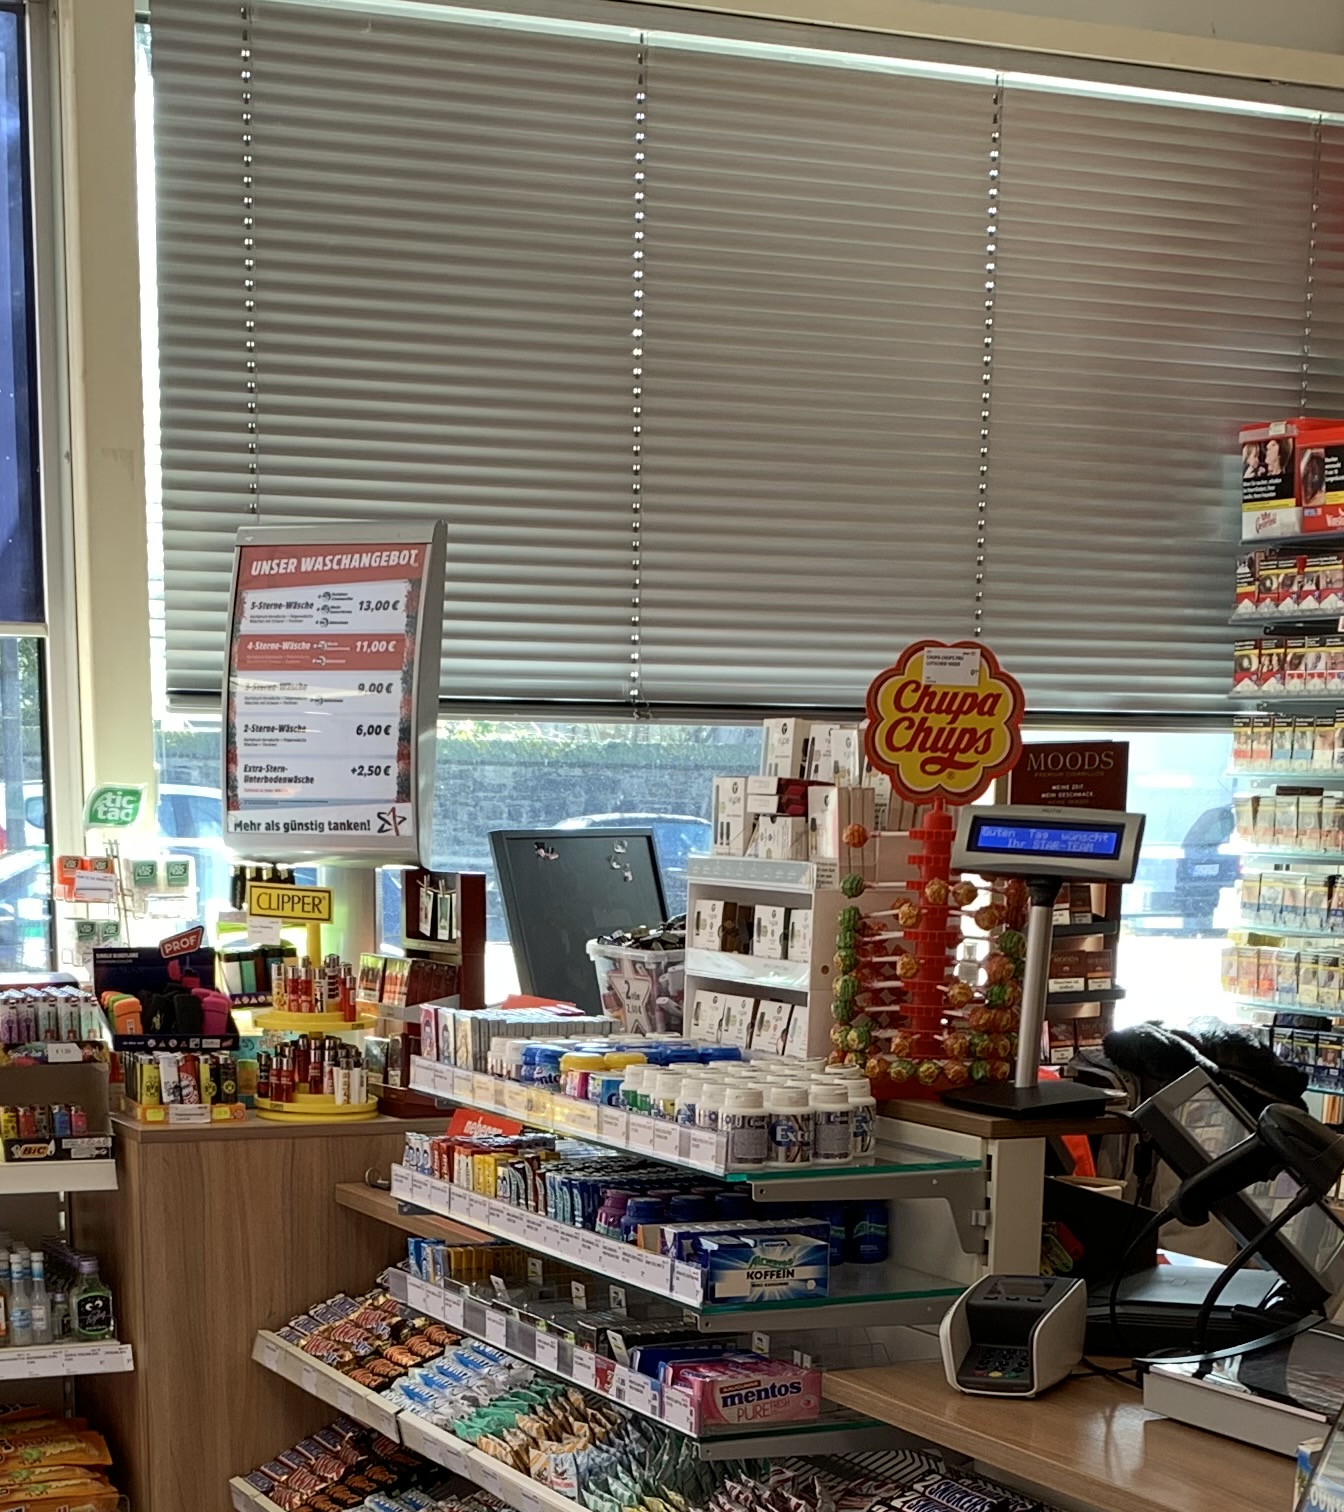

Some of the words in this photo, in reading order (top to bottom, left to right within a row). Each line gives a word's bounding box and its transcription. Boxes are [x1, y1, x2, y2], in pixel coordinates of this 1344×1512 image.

[251, 558, 296, 576] UNSER
[301, 550, 418, 572] WASCHANGEBOT
[358, 601, 389, 612] 13,00
[392, 600, 400, 610] €
[247, 642, 311, 650] 4-Sterne-Wäsche
[356, 642, 386, 653] 11,00
[388, 641, 396, 651] €
[893, 679, 1002, 724] Chupa
[356, 725, 382, 737] 6,00
[384, 725, 391, 735] €
[885, 717, 994, 775] Chups
[1027, 751, 1114, 771] MOODS
[351, 766, 381, 777] +2,50
[384, 765, 391, 776] €
[235, 820, 261, 831] Mehr
[264, 820, 280, 831] als
[284, 820, 324, 835] günstig
[328, 819, 371, 831] tanken!
[1008, 839, 1025, 848] Ihr
[257, 893, 322, 913] CLIPPER
[164, 934, 197, 953] PROF
[747, 1270, 795, 1280] KOFFEIN
[721, 1380, 802, 1408] mentos
[737, 1402, 770, 1421] PURE
